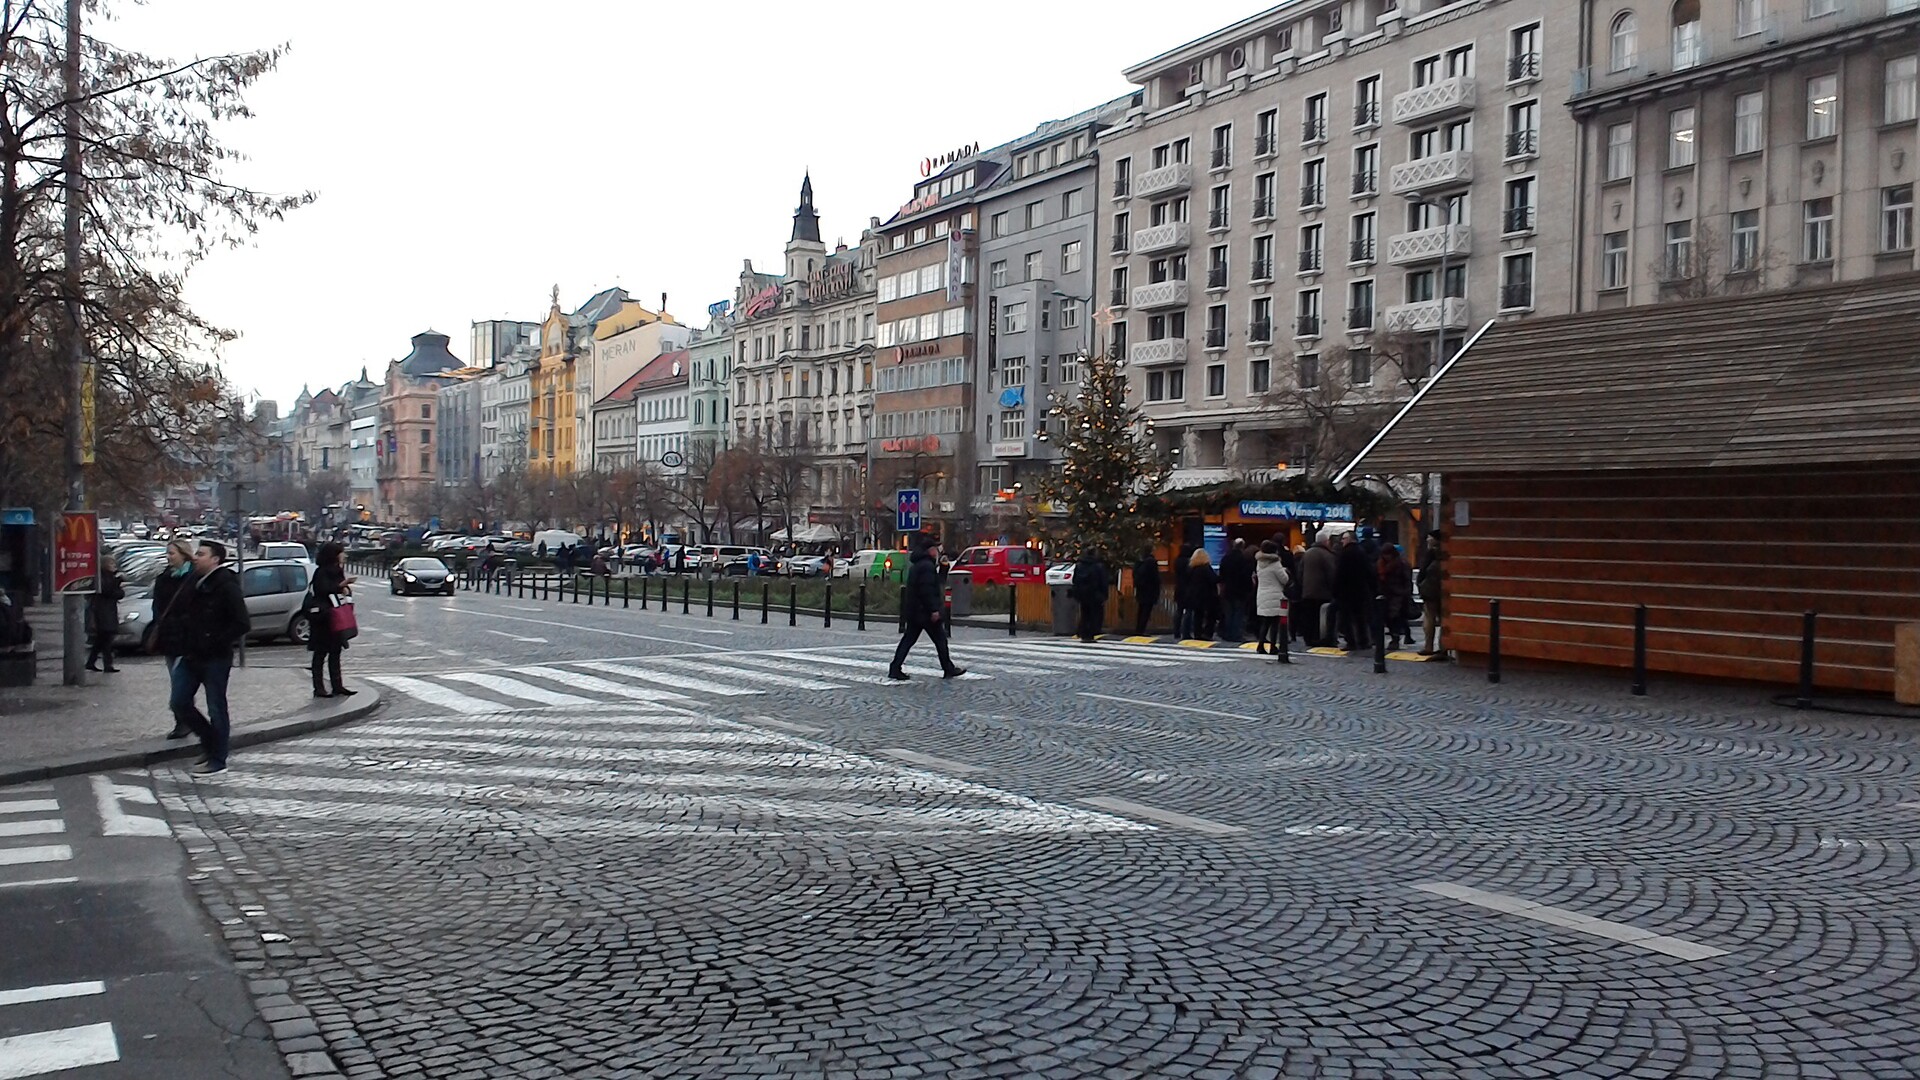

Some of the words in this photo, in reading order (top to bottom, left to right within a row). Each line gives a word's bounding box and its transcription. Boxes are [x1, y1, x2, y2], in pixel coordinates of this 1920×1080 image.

[932, 140, 980, 169] RAMADA
[951, 246, 960, 302] RAMADA
[601, 338, 636, 361] MERAN
[904, 342, 940, 359] RAMADA
[1325, 506, 1350, 518] 2014
